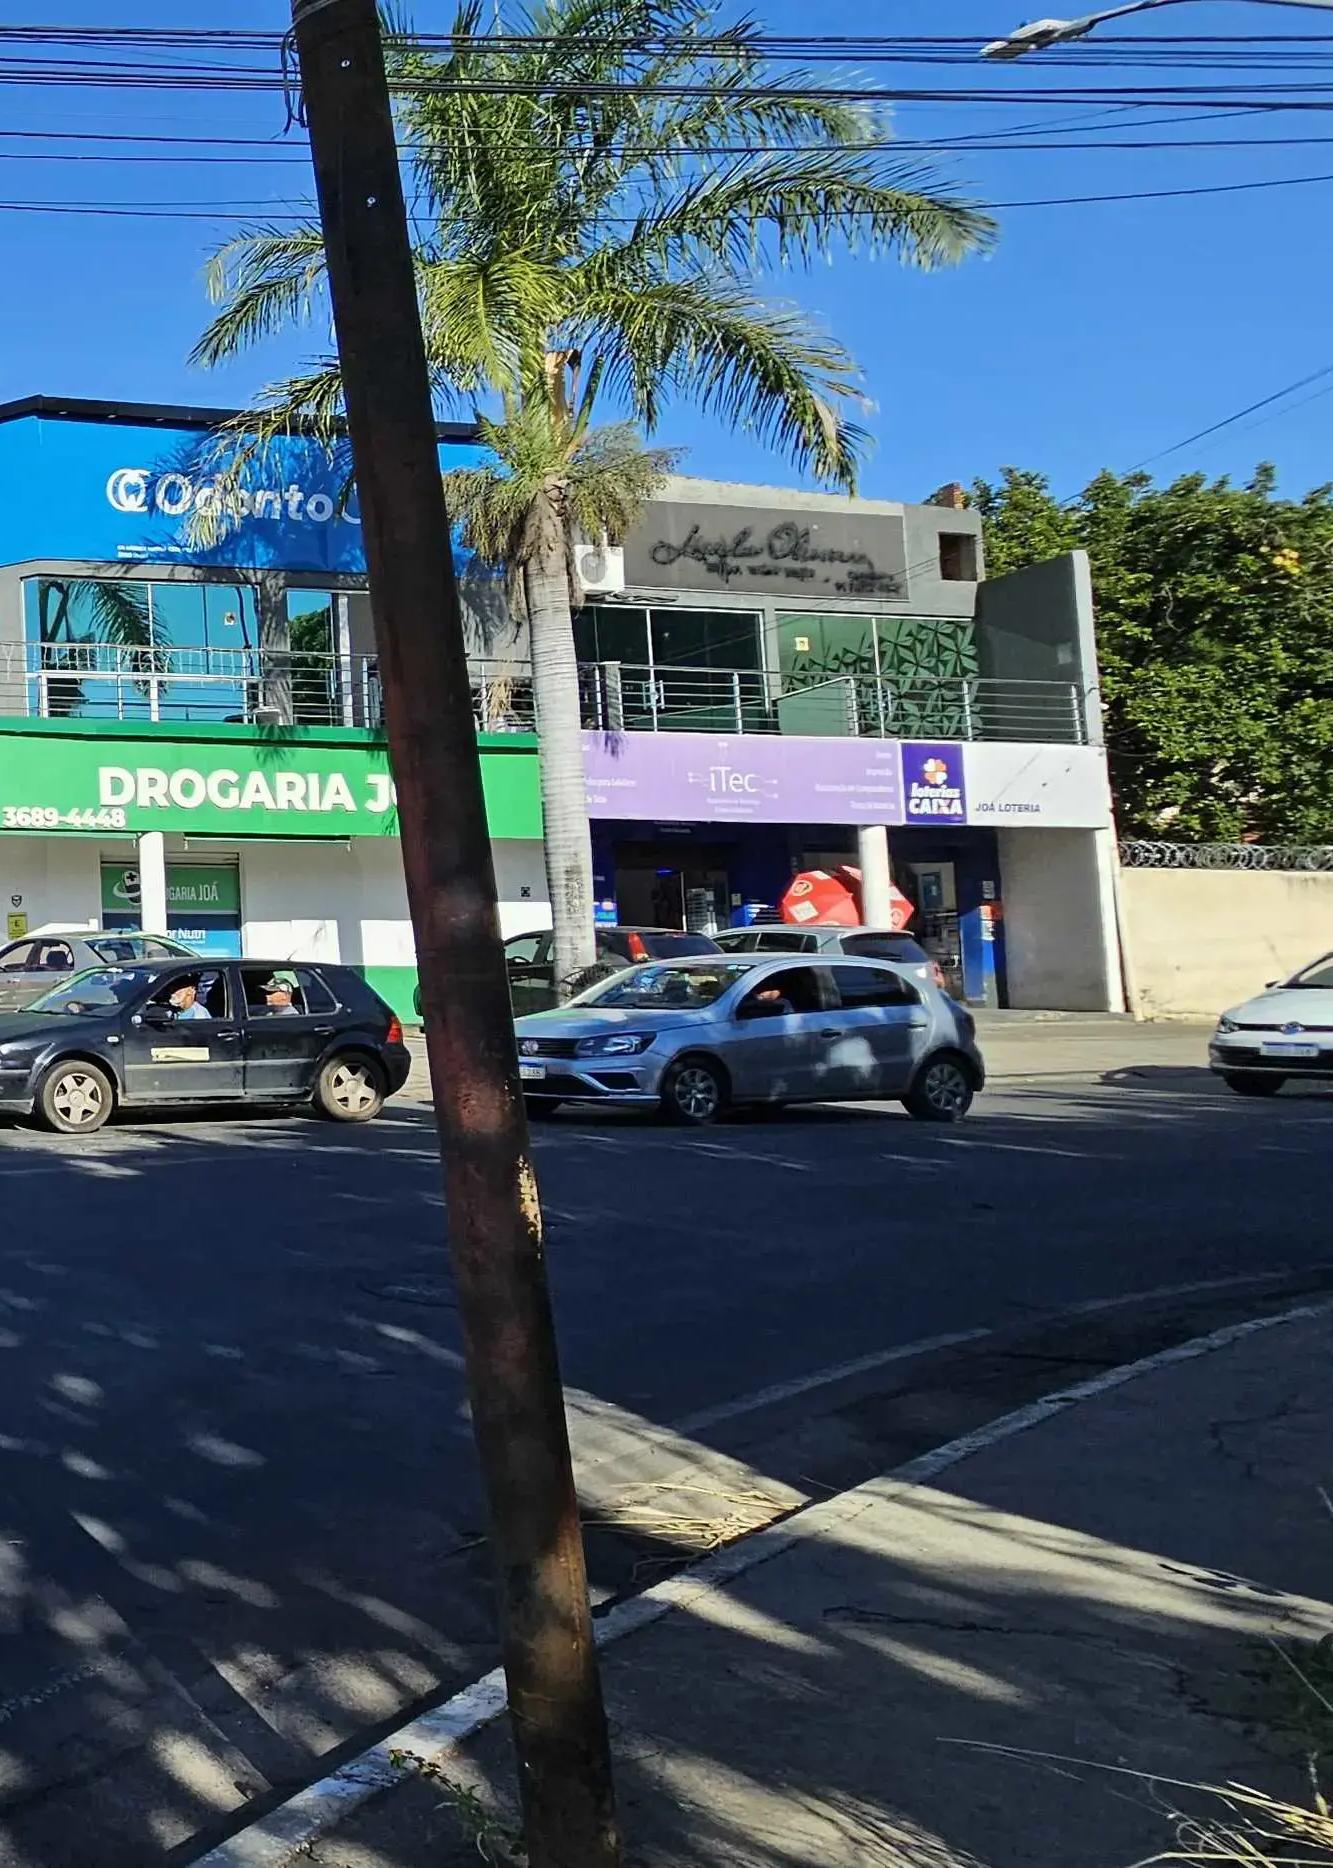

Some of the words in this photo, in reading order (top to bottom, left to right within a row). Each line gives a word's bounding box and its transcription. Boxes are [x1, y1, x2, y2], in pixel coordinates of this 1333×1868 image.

[98, 766, 358, 812] DROGARIA
[708, 765, 759, 793] iTec
[910, 782, 961, 799] loterias
[908, 798, 963, 815] CAIXA
[998, 803, 1041, 813] LOTERIA
[1, 806, 127, 829] 3689-4448
[198, 881, 219, 901] JOÁ
